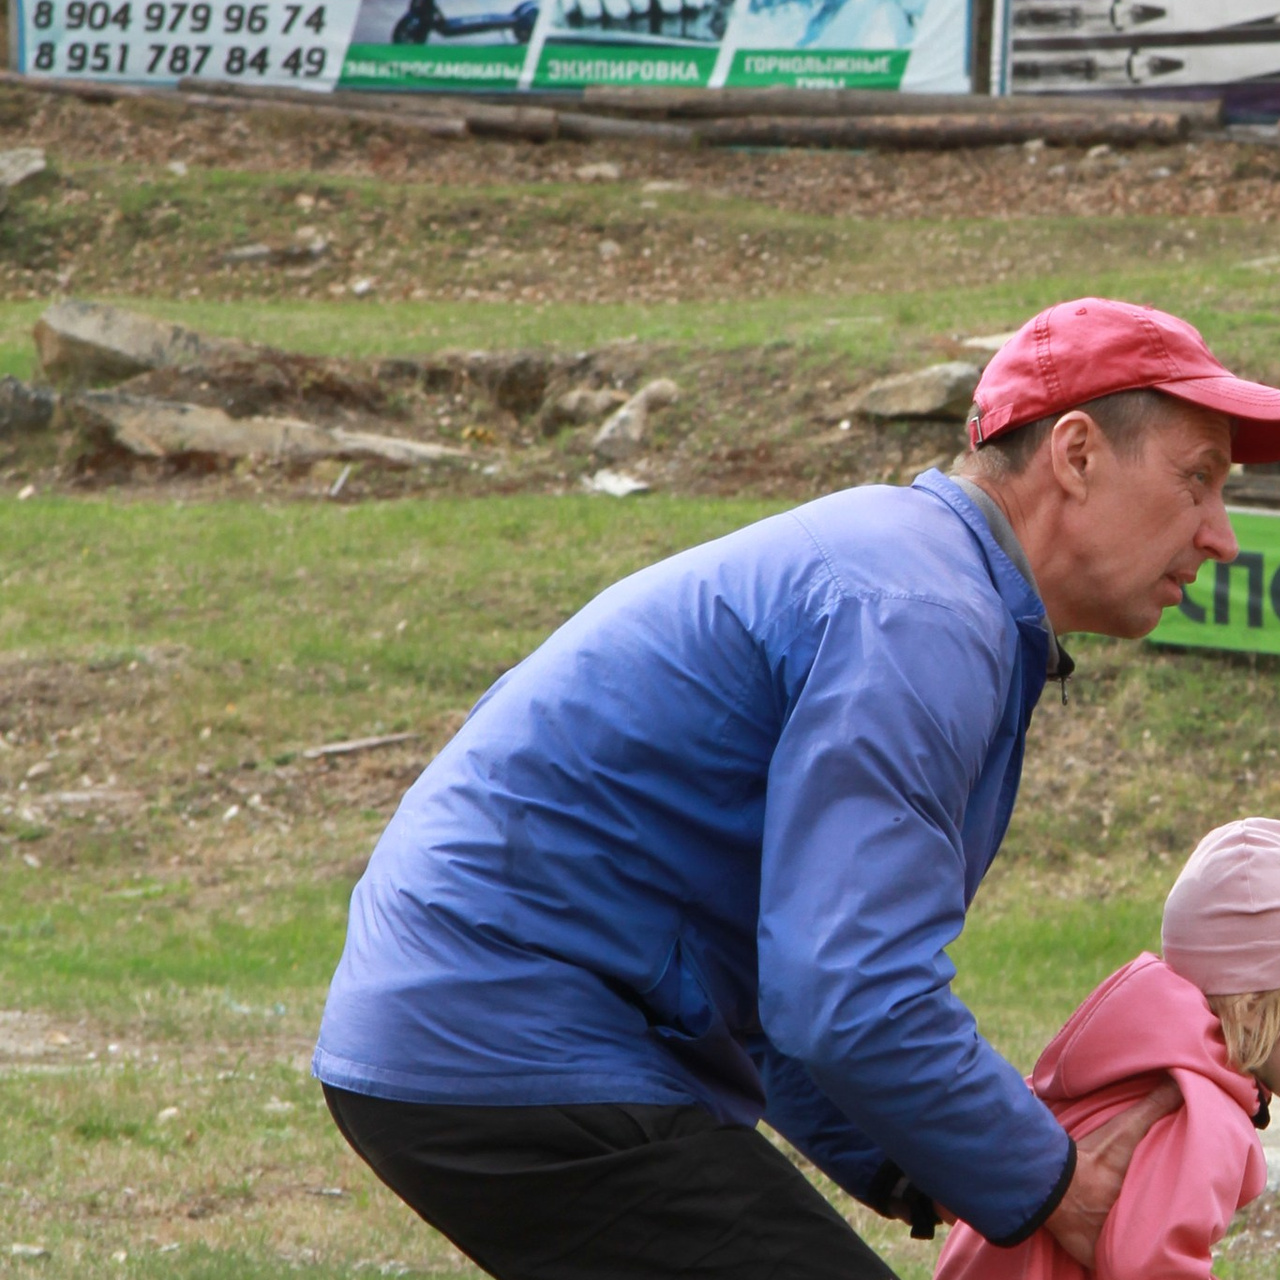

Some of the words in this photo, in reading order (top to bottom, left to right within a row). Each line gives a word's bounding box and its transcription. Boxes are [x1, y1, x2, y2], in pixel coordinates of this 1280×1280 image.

[33, 1, 54, 30] 8
[65, 1, 133, 31] 904
[144, 3, 213, 33] 979
[224, 4, 269, 34] 96
[282, 5, 327, 35] 74
[34, 42, 56, 71] 8
[67, 42, 129, 73] 951
[148, 44, 213, 75] 787
[224, 46, 269, 75] 84
[282, 47, 327, 77] 49
[548, 60, 699, 81] ЭКИПИРОВКА
